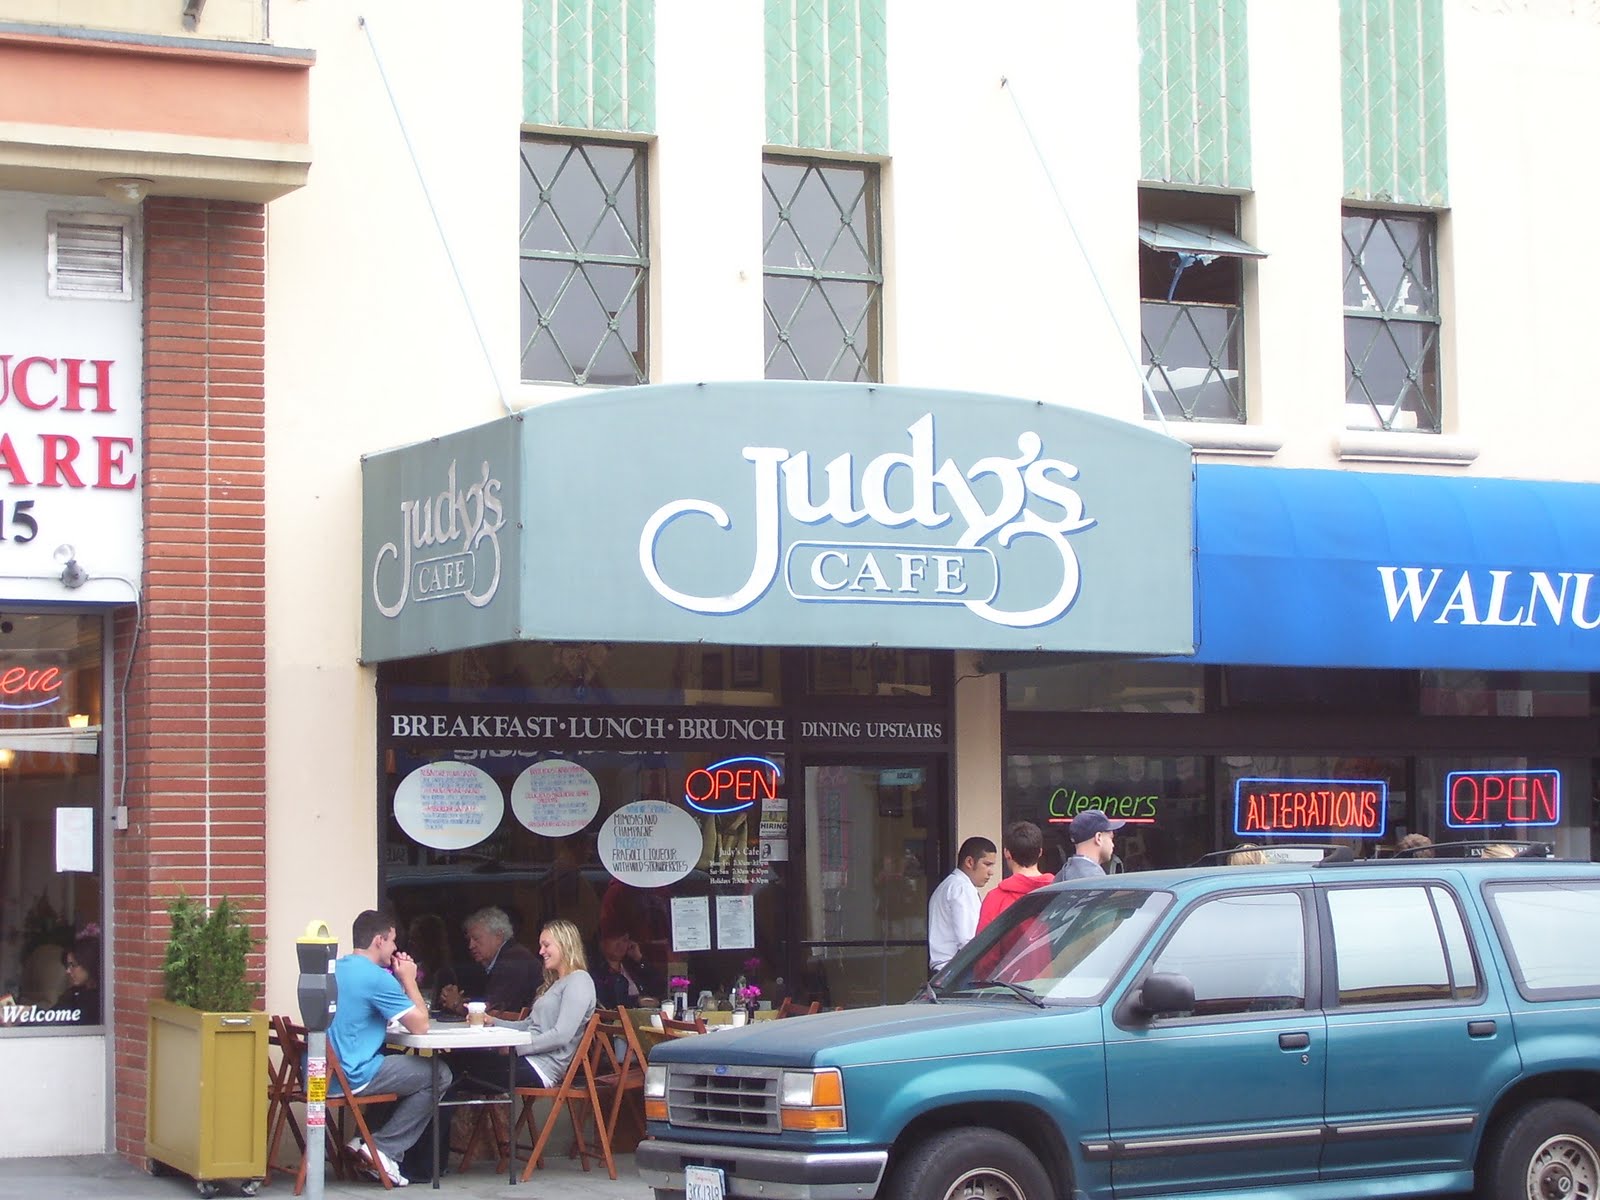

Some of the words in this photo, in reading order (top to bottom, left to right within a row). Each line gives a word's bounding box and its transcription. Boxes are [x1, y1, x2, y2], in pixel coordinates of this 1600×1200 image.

[0, 433, 137, 490] ARE
[638, 412, 1098, 629] Judy's
[373, 459, 507, 618] Judy's
[419, 560, 466, 594] CAFE
[810, 550, 969, 595] CAFE
[1376, 566, 1600, 630] WALNU
[391, 715, 559, 738] BREAKFAST
[567, 717, 666, 738] LUNCH
[678, 718, 786, 740] BRUNCH
[801, 720, 861, 738] DINING
[865, 722, 942, 739] UPSTAIRS
[685, 769, 777, 801] OPEN
[1451, 776, 1557, 822] OPEN
[1048, 788, 1159, 817] Cleaners
[1245, 791, 1377, 830] ALTERATIONS
[644, 814, 658, 825] AND
[760, 822, 788, 830] HIRING
[612, 861, 629, 872] WITH
[719, 847, 741, 858] Judy's
[743, 847, 760, 856] Cafe
[3, 1004, 82, 1023] Welcome
